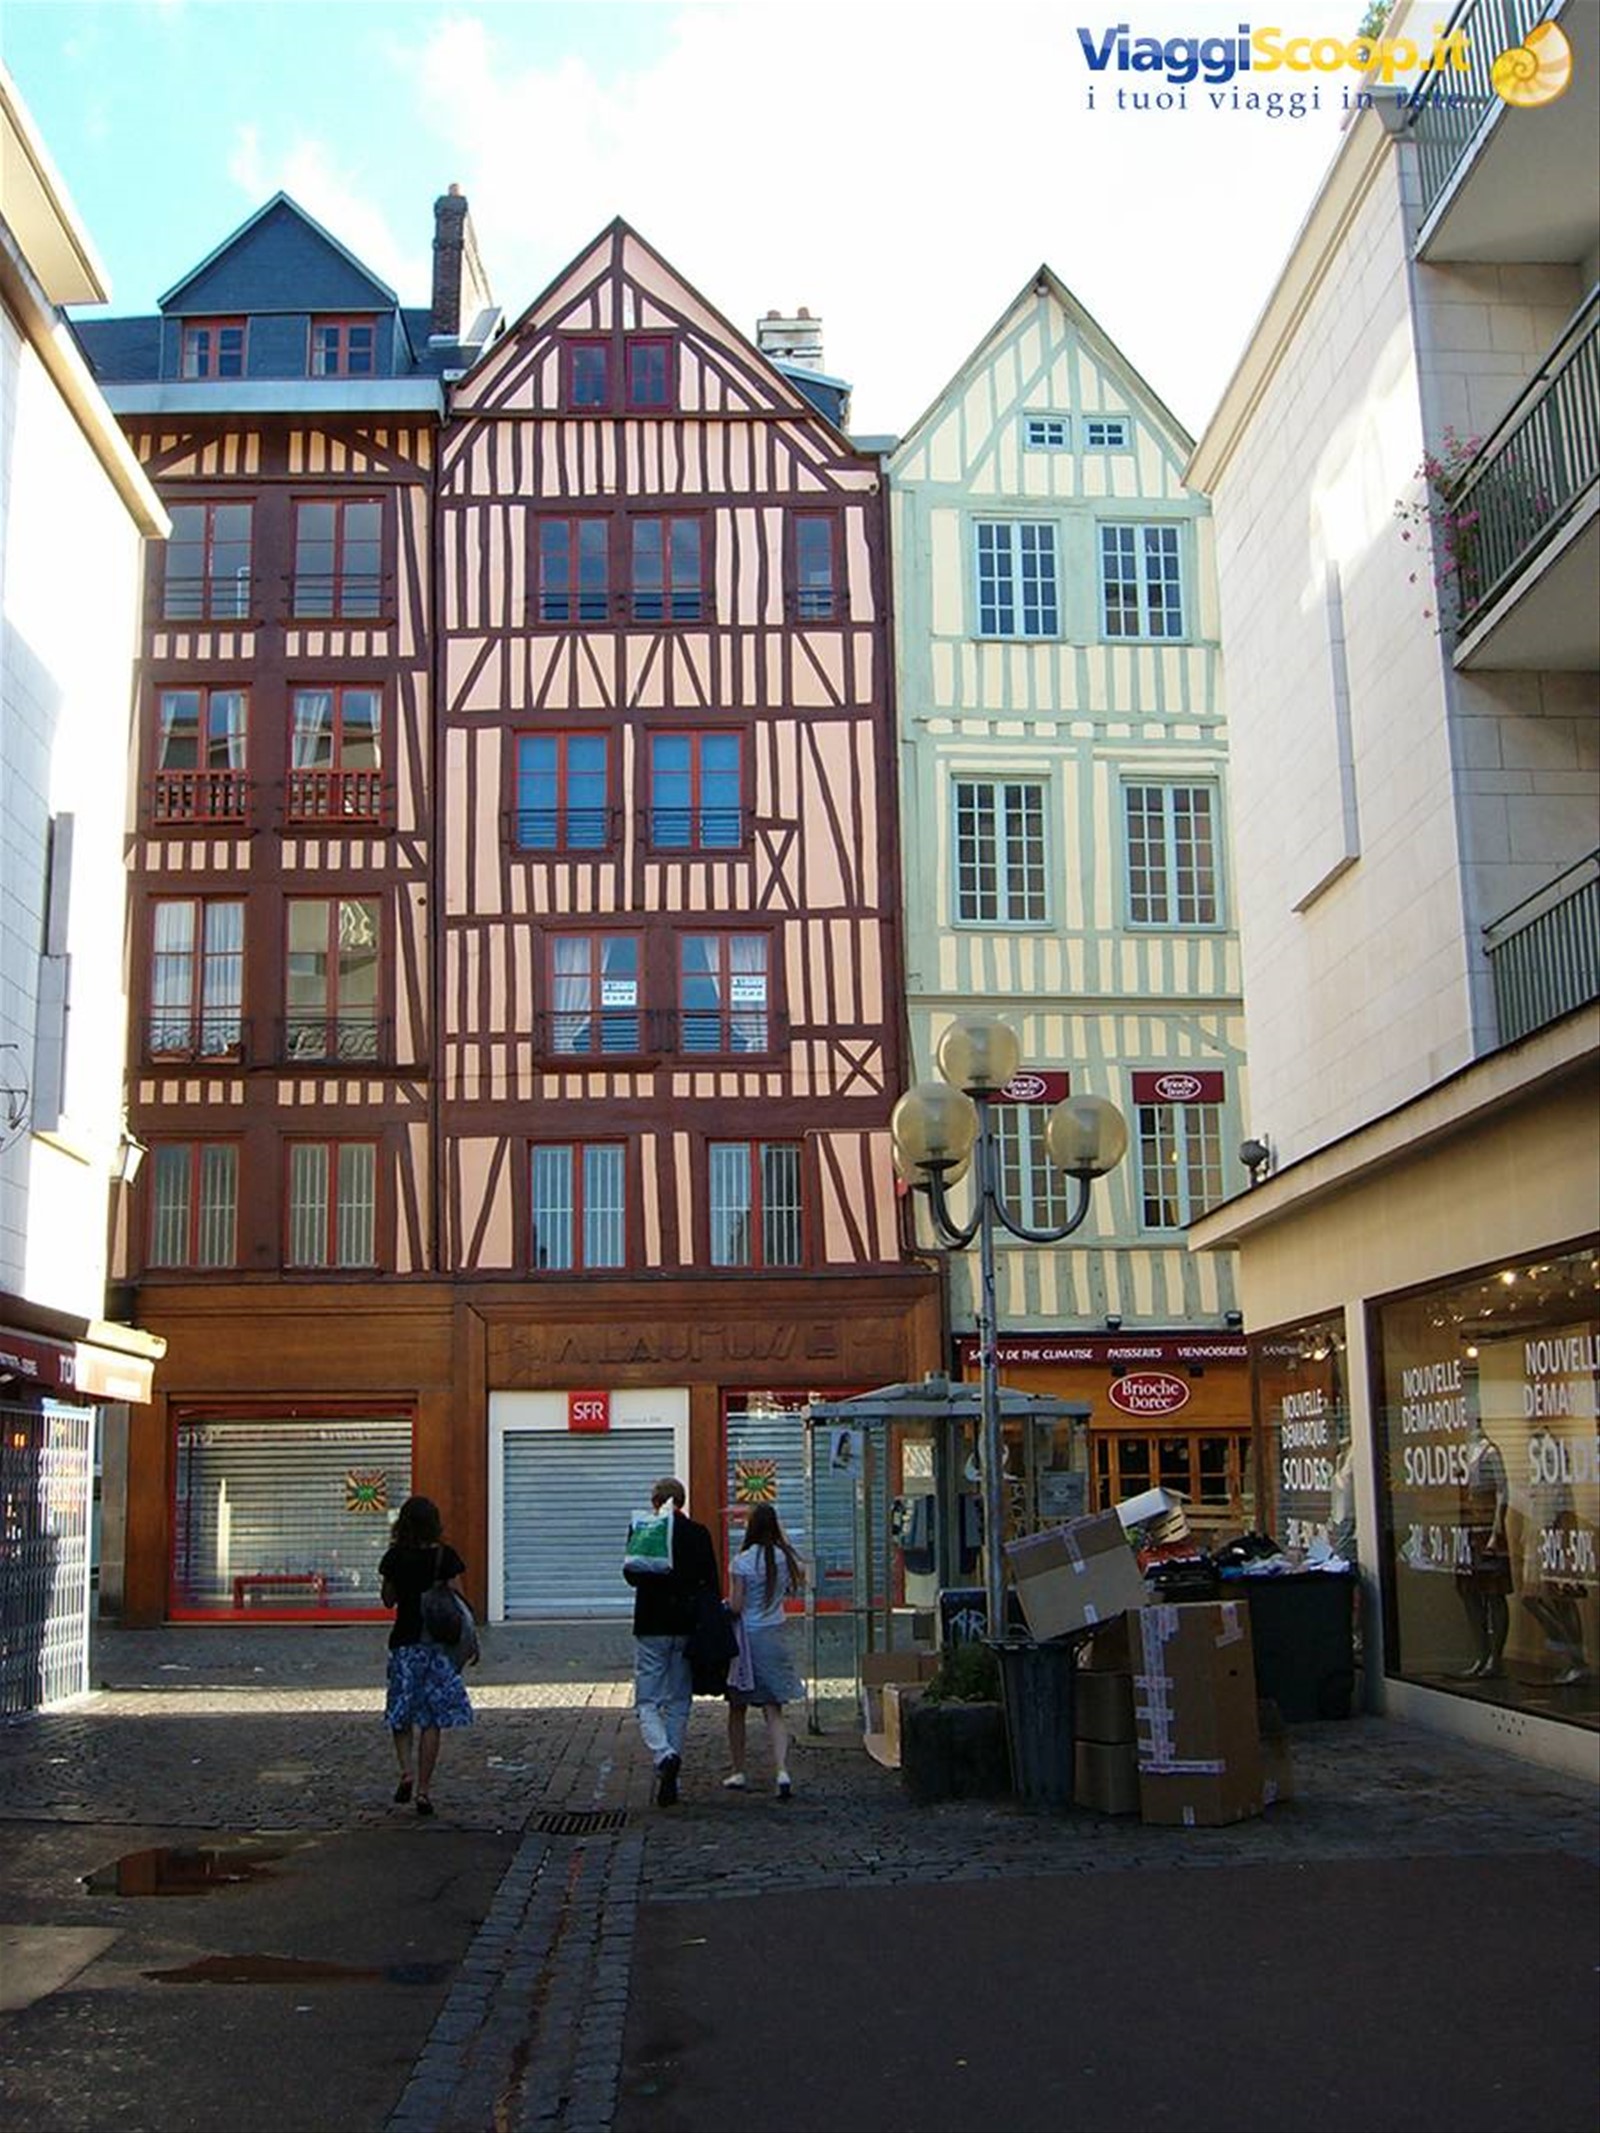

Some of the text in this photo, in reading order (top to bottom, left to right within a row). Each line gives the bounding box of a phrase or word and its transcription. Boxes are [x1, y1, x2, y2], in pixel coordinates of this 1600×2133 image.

[1006, 1349, 1020, 1360] DE
[1121, 1378, 1180, 1397] Brioche
[1402, 1360, 1462, 1397] NOUVELLE
[572, 1400, 605, 1421] SFR
[1402, 1397, 1468, 1435] DÉMARQUE
[1282, 1457, 1330, 1491] SOLDES
[1404, 1444, 1470, 1487] SOLDES
